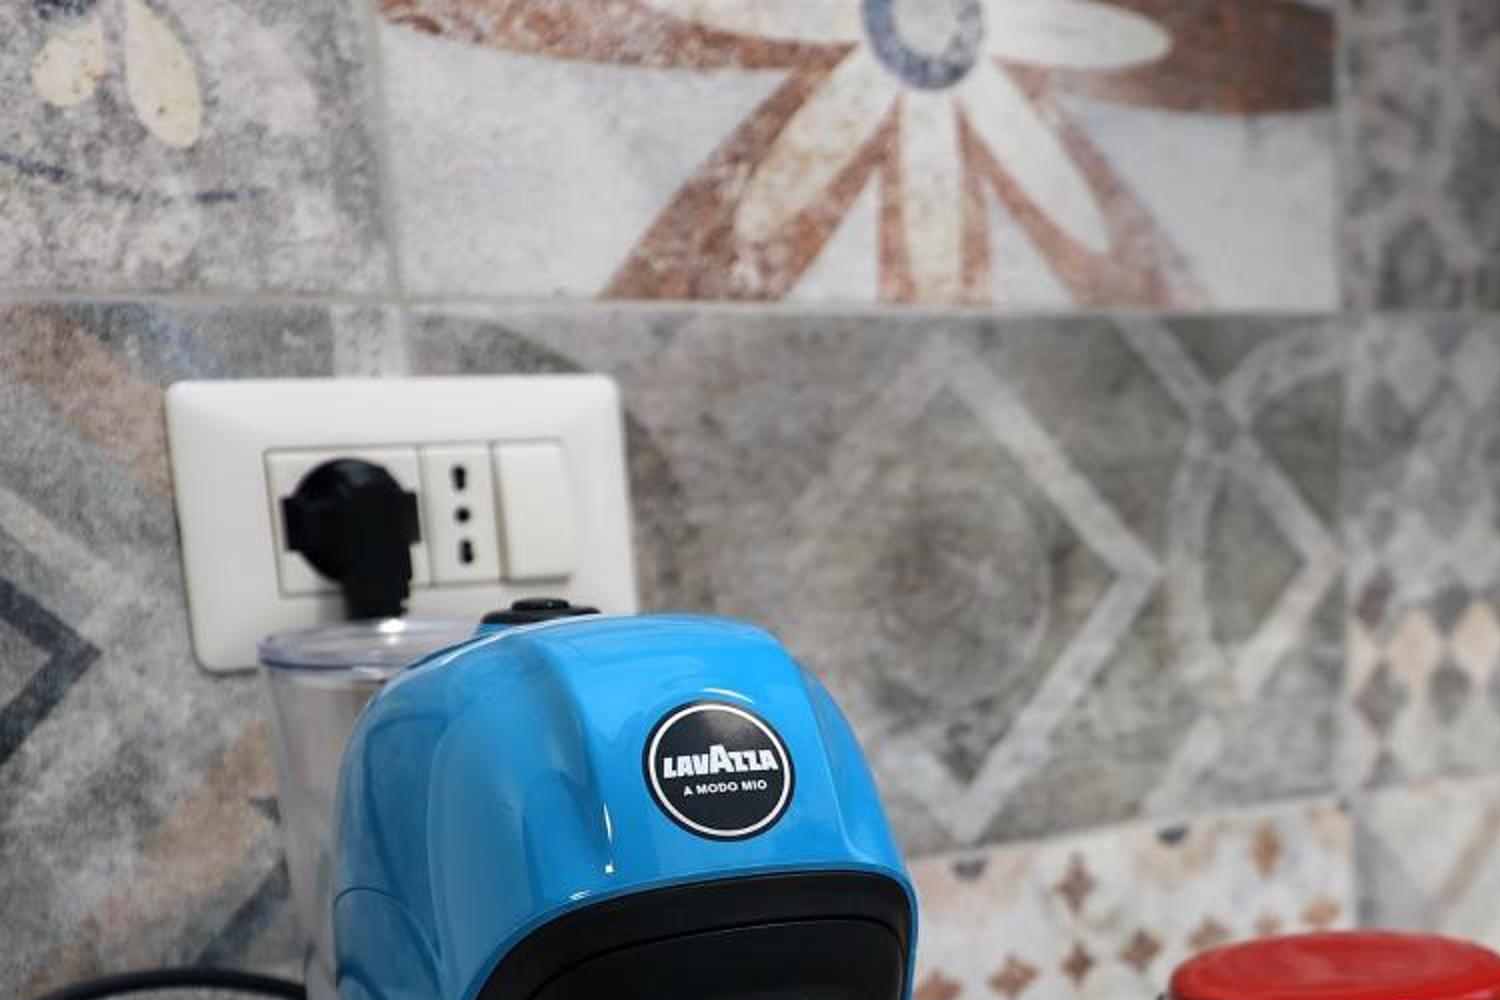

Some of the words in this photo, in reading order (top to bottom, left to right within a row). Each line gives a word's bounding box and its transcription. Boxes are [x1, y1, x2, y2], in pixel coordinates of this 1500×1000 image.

[663, 744, 779, 779] LAVAZZA
[683, 785, 694, 797] A
[695, 781, 738, 795] MODO
[741, 779, 767, 791] MIO
